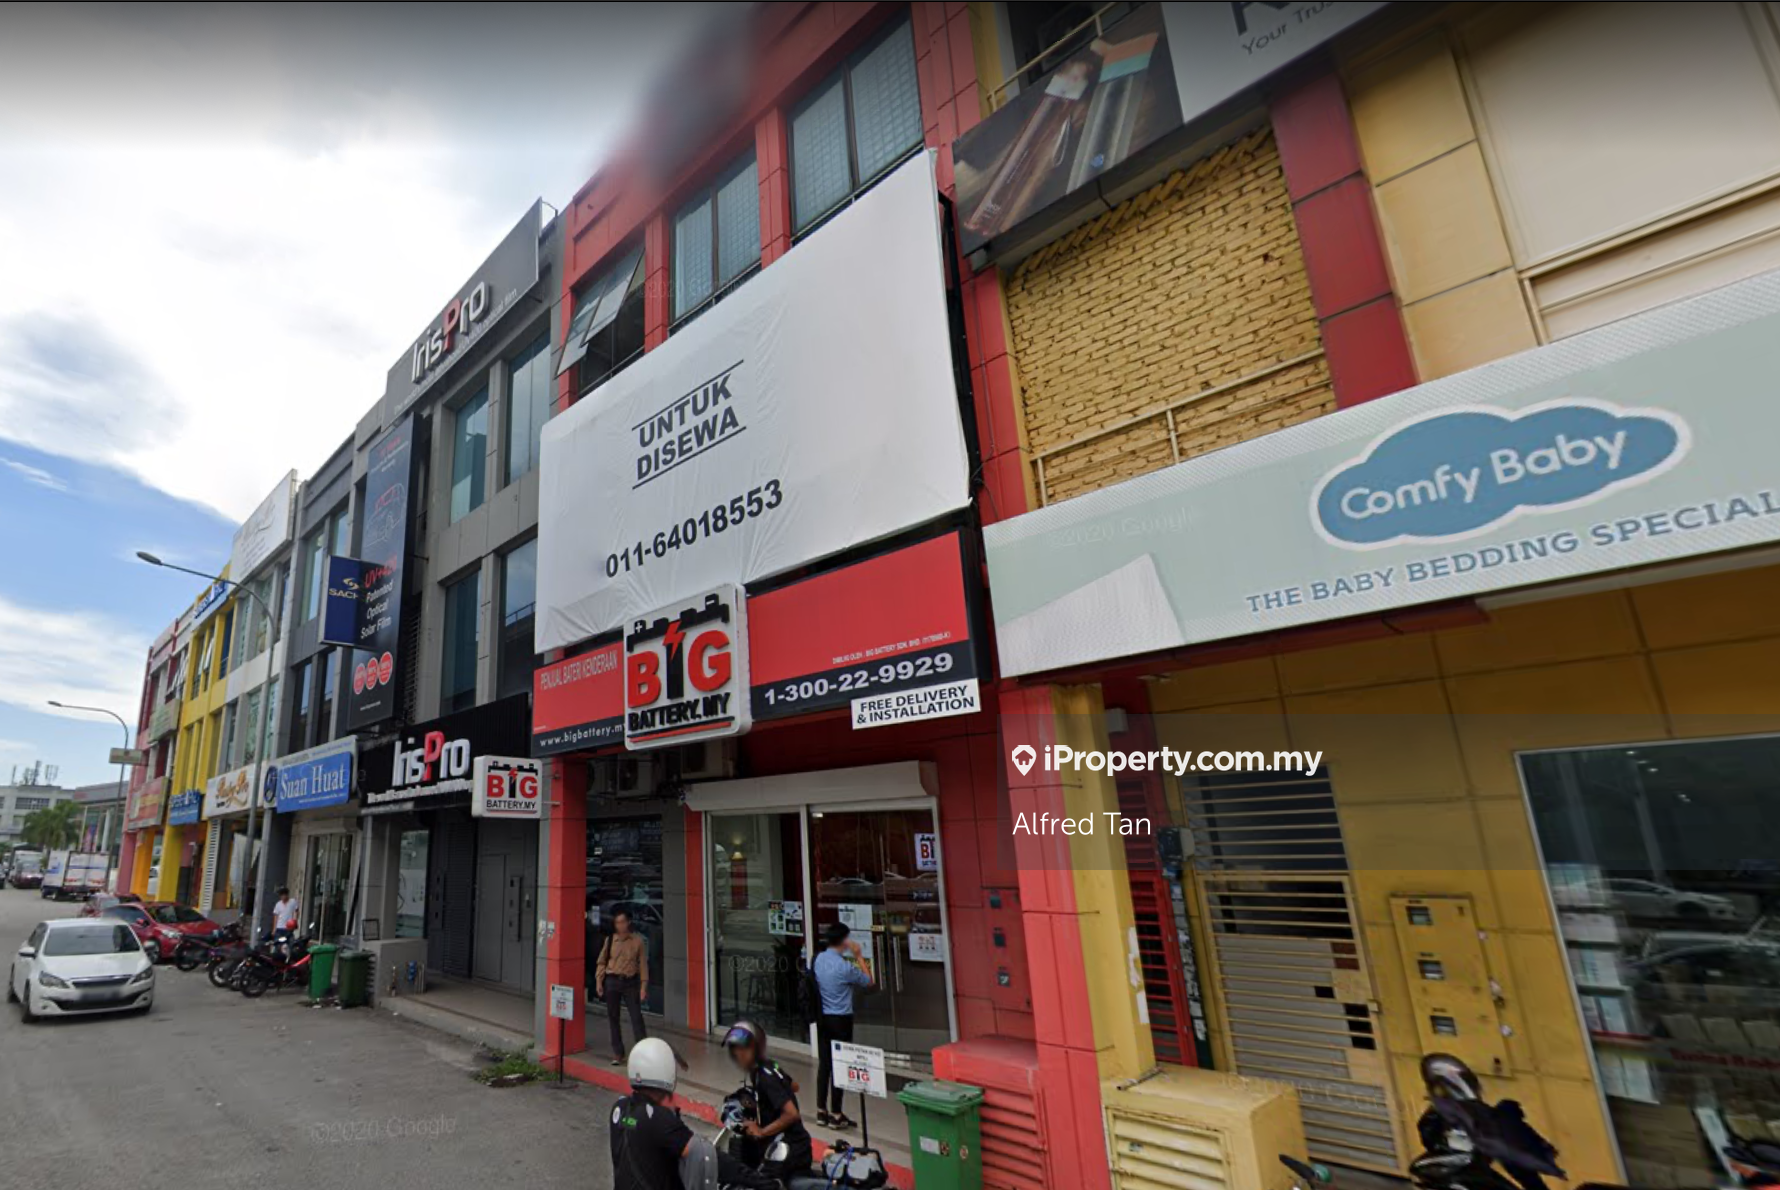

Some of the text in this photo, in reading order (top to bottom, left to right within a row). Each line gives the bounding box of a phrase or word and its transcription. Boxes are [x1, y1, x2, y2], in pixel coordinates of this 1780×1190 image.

[1242, 24, 1288, 55] Your
[411, 281, 487, 383] IrisPro
[639, 373, 732, 448] UNTUK
[637, 406, 740, 480] DISEWA
[1339, 429, 1627, 520] Comfy Baby
[605, 478, 783, 578] 011-64018553
[1246, 491, 1780, 613] THE BABY BEDDING SPECIAL
[627, 621, 731, 708] BIG
[764, 652, 953, 705] 1-300-22-9929
[628, 692, 731, 731] BATTERY.MY
[857, 697, 974, 724] & INSTALLATION
[861, 685, 968, 713] FREE DELIVERY
[540, 723, 625, 747] www.bigbattery.m
[280, 772, 308, 800] Suan
[311, 763, 345, 794] Huat
[486, 768, 538, 798] BIG
[486, 800, 536, 810] BATTERY.MY
